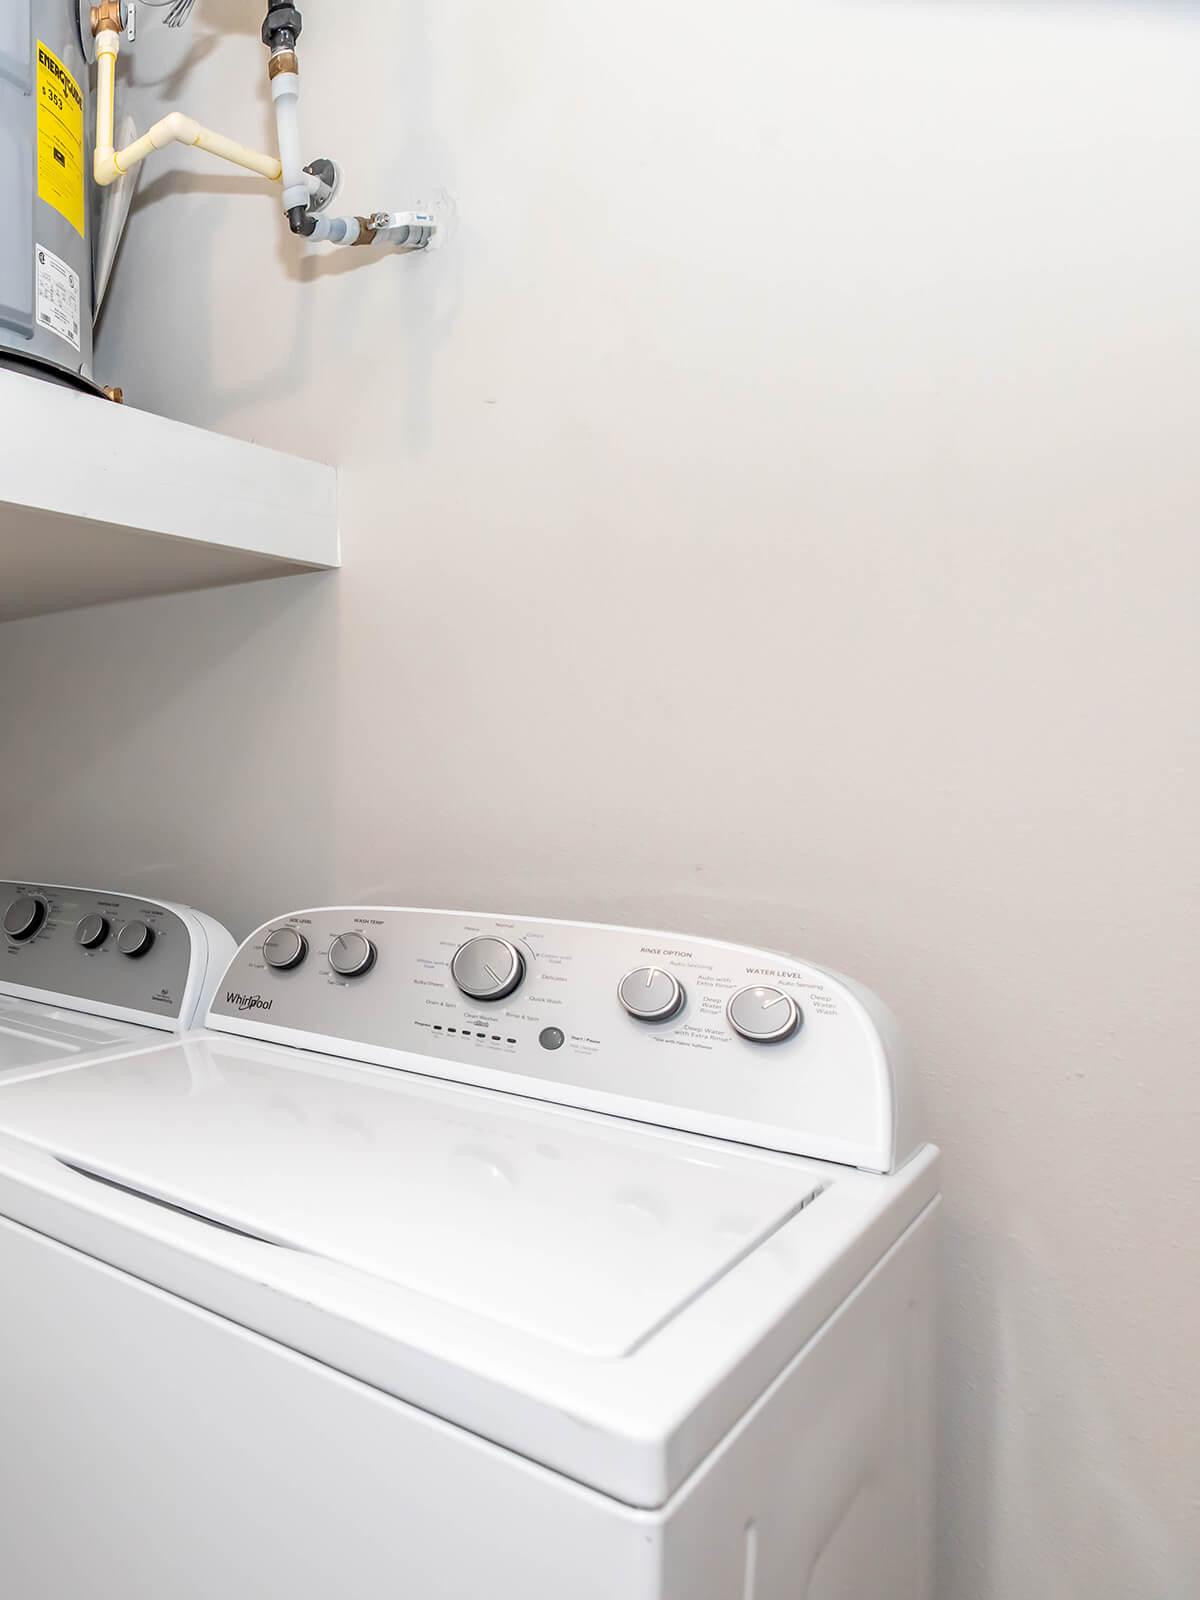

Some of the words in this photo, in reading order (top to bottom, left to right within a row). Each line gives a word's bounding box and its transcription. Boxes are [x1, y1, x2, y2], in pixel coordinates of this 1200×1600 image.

[48, 89, 63, 110] 353
[640, 947, 661, 955] RINSE
[663, 950, 693, 958] OPTION
[746, 967, 775, 976] WATER
[777, 971, 803, 979] LEVEL
[226, 991, 273, 1010] Whirlpool
